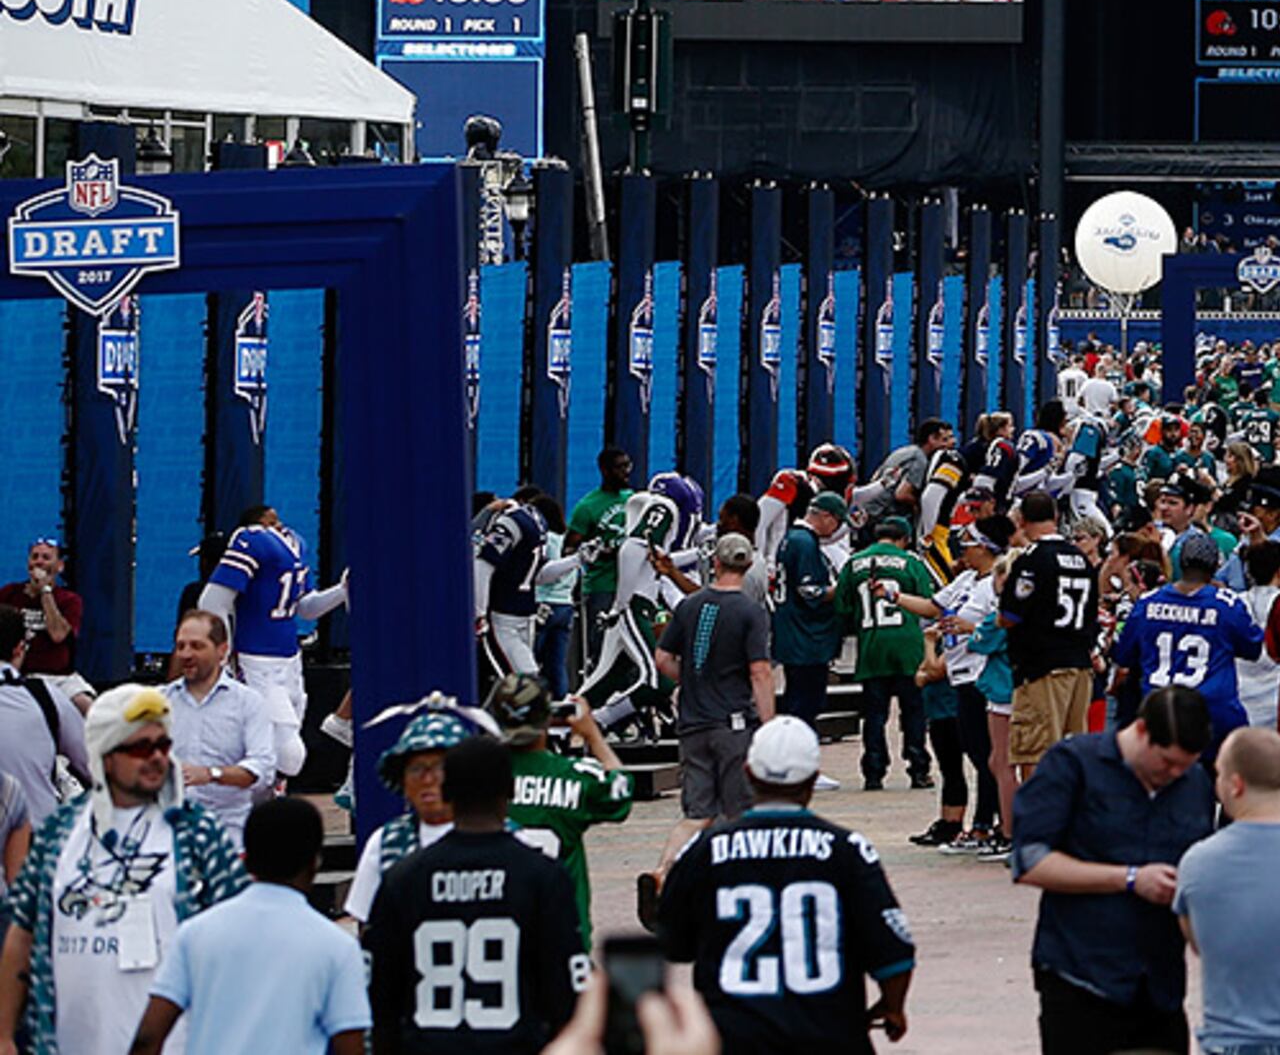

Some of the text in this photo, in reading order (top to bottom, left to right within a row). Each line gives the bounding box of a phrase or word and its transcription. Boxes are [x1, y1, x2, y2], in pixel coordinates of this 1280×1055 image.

[390, 18, 521, 32] ROUND 1 PICK 1
[1206, 46, 1248, 57] ROUND
[75, 181, 111, 208] NFL
[22, 225, 164, 259] DRAFT
[78, 269, 113, 284] 2017
[857, 579, 903, 629] 12
[1054, 577, 1091, 628] 57
[1146, 602, 1218, 626] BECKHAM JR
[1149, 632, 1211, 688] 13
[710, 827, 835, 864] DAWKINS
[431, 869, 507, 903] COOPER
[92, 936, 119, 954] DR
[716, 881, 842, 996] 20
[413, 917, 521, 1030] 89
